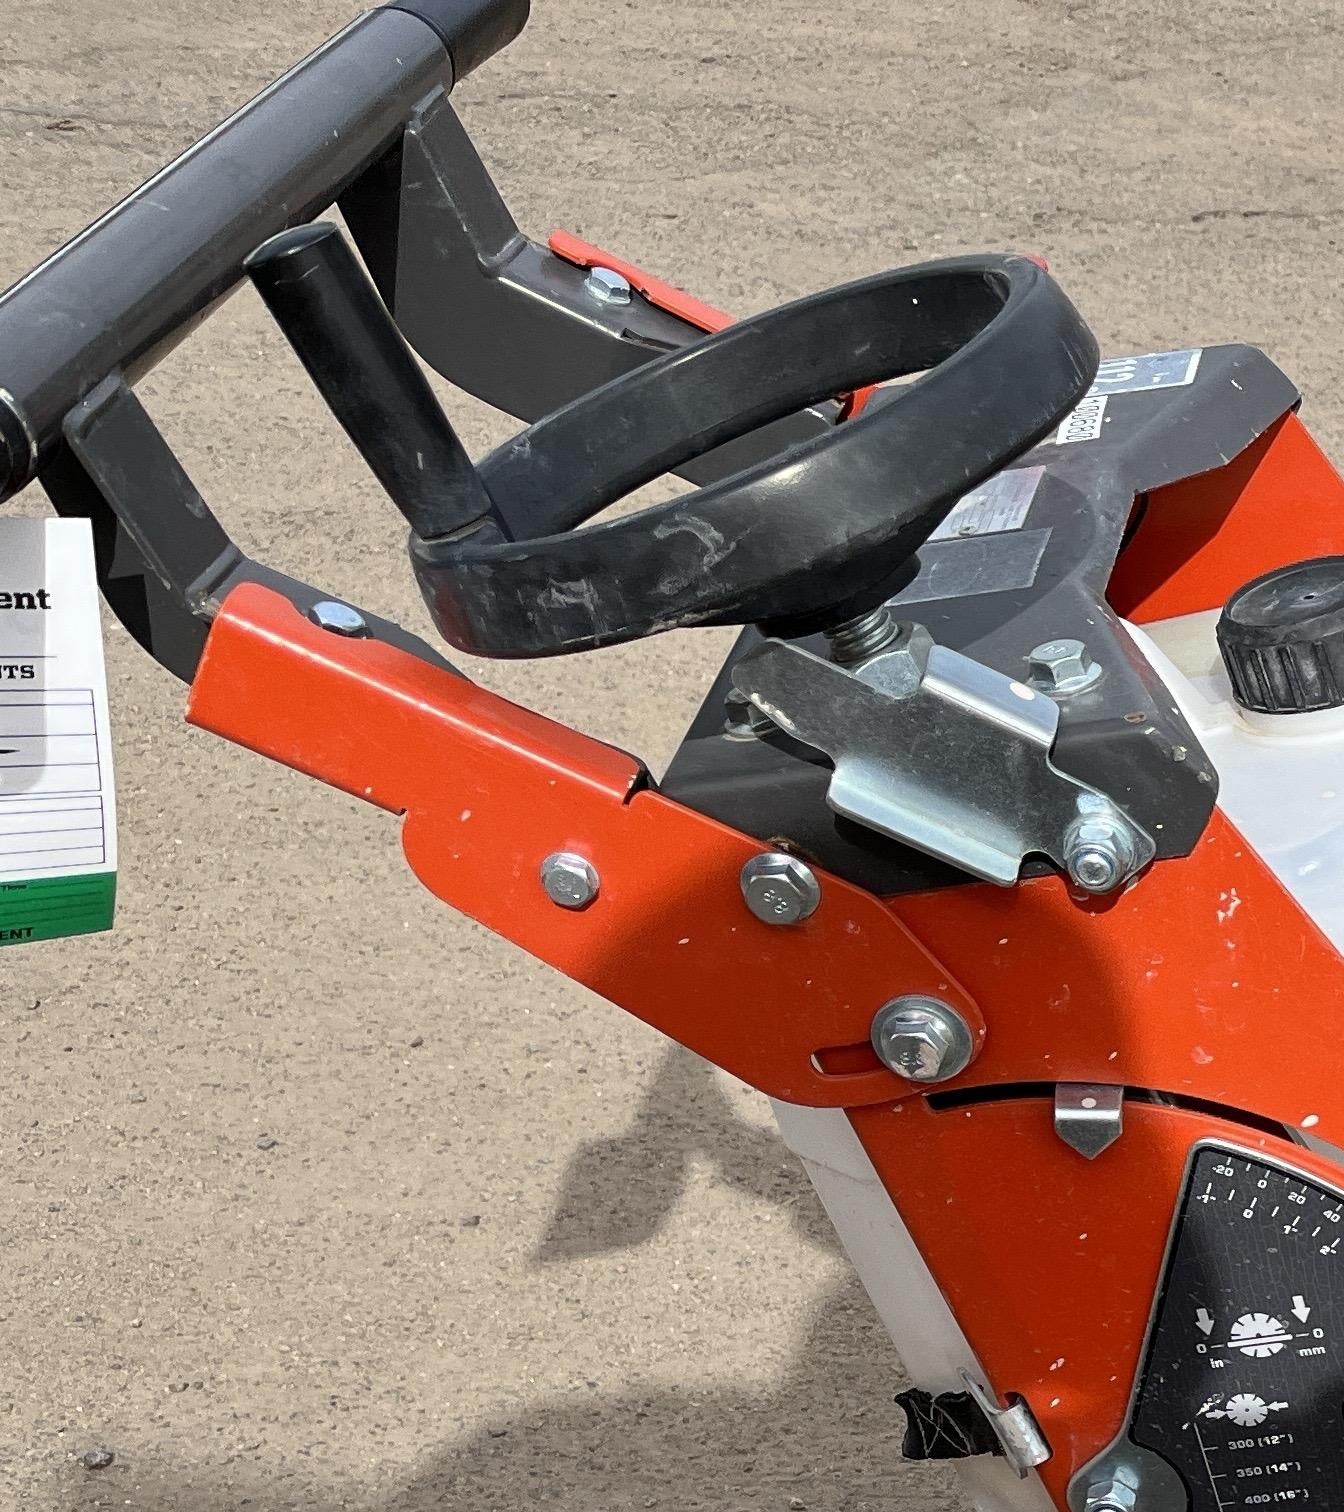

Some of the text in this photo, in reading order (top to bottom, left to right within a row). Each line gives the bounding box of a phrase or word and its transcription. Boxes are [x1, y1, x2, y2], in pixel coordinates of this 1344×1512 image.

[1257, 1179, 1268, 1189] 0
[1287, 1192, 1306, 1205] 20
[1323, 1210, 1341, 1223] 40
[1242, 1208, 1254, 1219] 0
[1312, 1327, 1324, 1339] 0
[1195, 1343, 1208, 1354] 0
[1299, 1345, 1327, 1357] mm
[1210, 1358, 1225, 1369] in
[1228, 1438, 1255, 1450] 300
[1236, 1466, 1262, 1478] 350
[1244, 1494, 1271, 1505] 400
